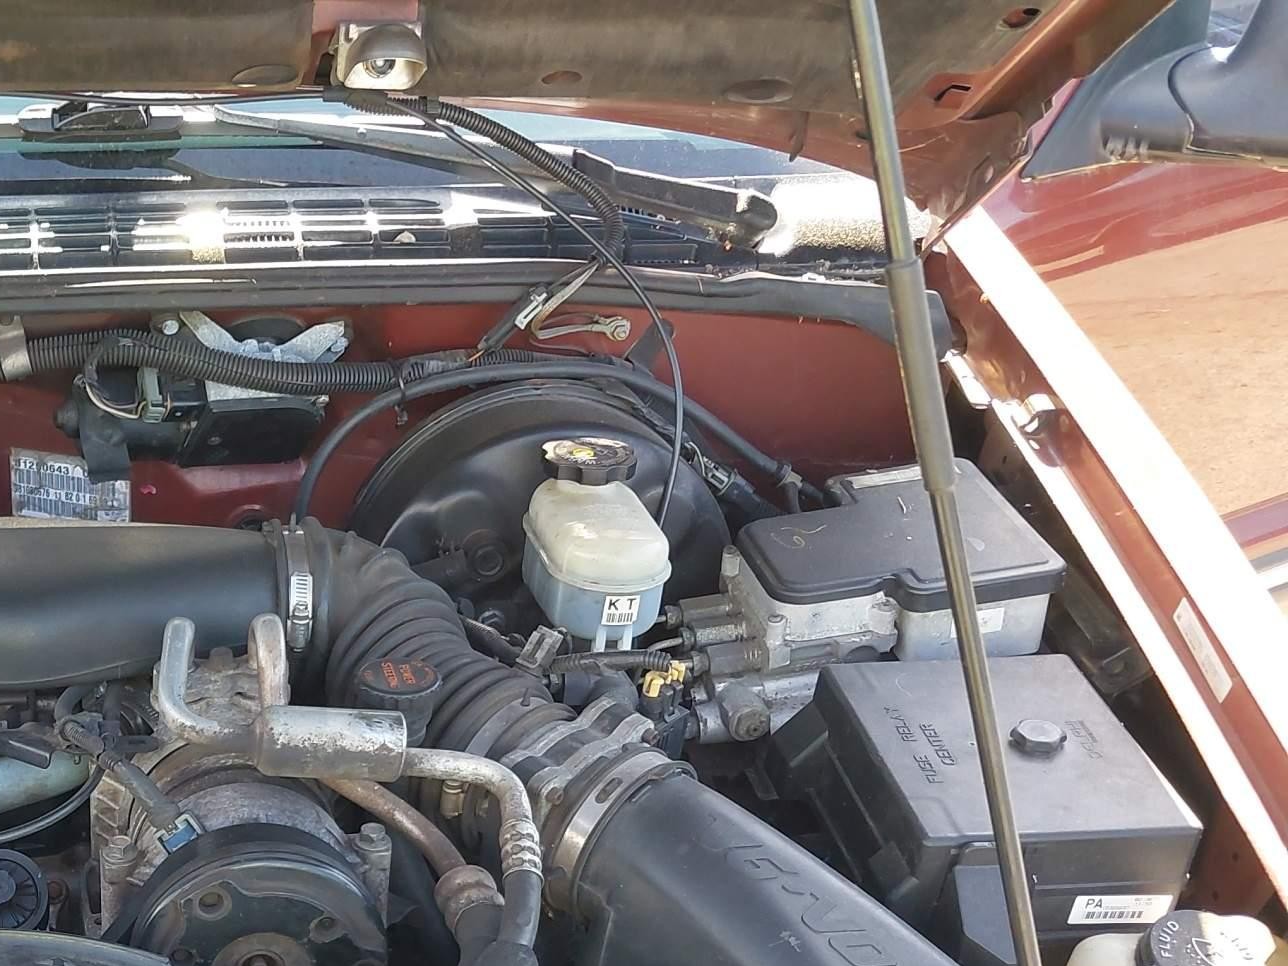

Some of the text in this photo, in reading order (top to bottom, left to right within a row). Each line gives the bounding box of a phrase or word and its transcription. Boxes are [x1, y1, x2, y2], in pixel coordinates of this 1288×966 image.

[608, 597, 637, 611] K T
[883, 704, 944, 784] FUSE RELAY
[919, 719, 958, 767] CENTER
[1085, 898, 1103, 909] PA
[1160, 920, 1180, 958] FLUID
